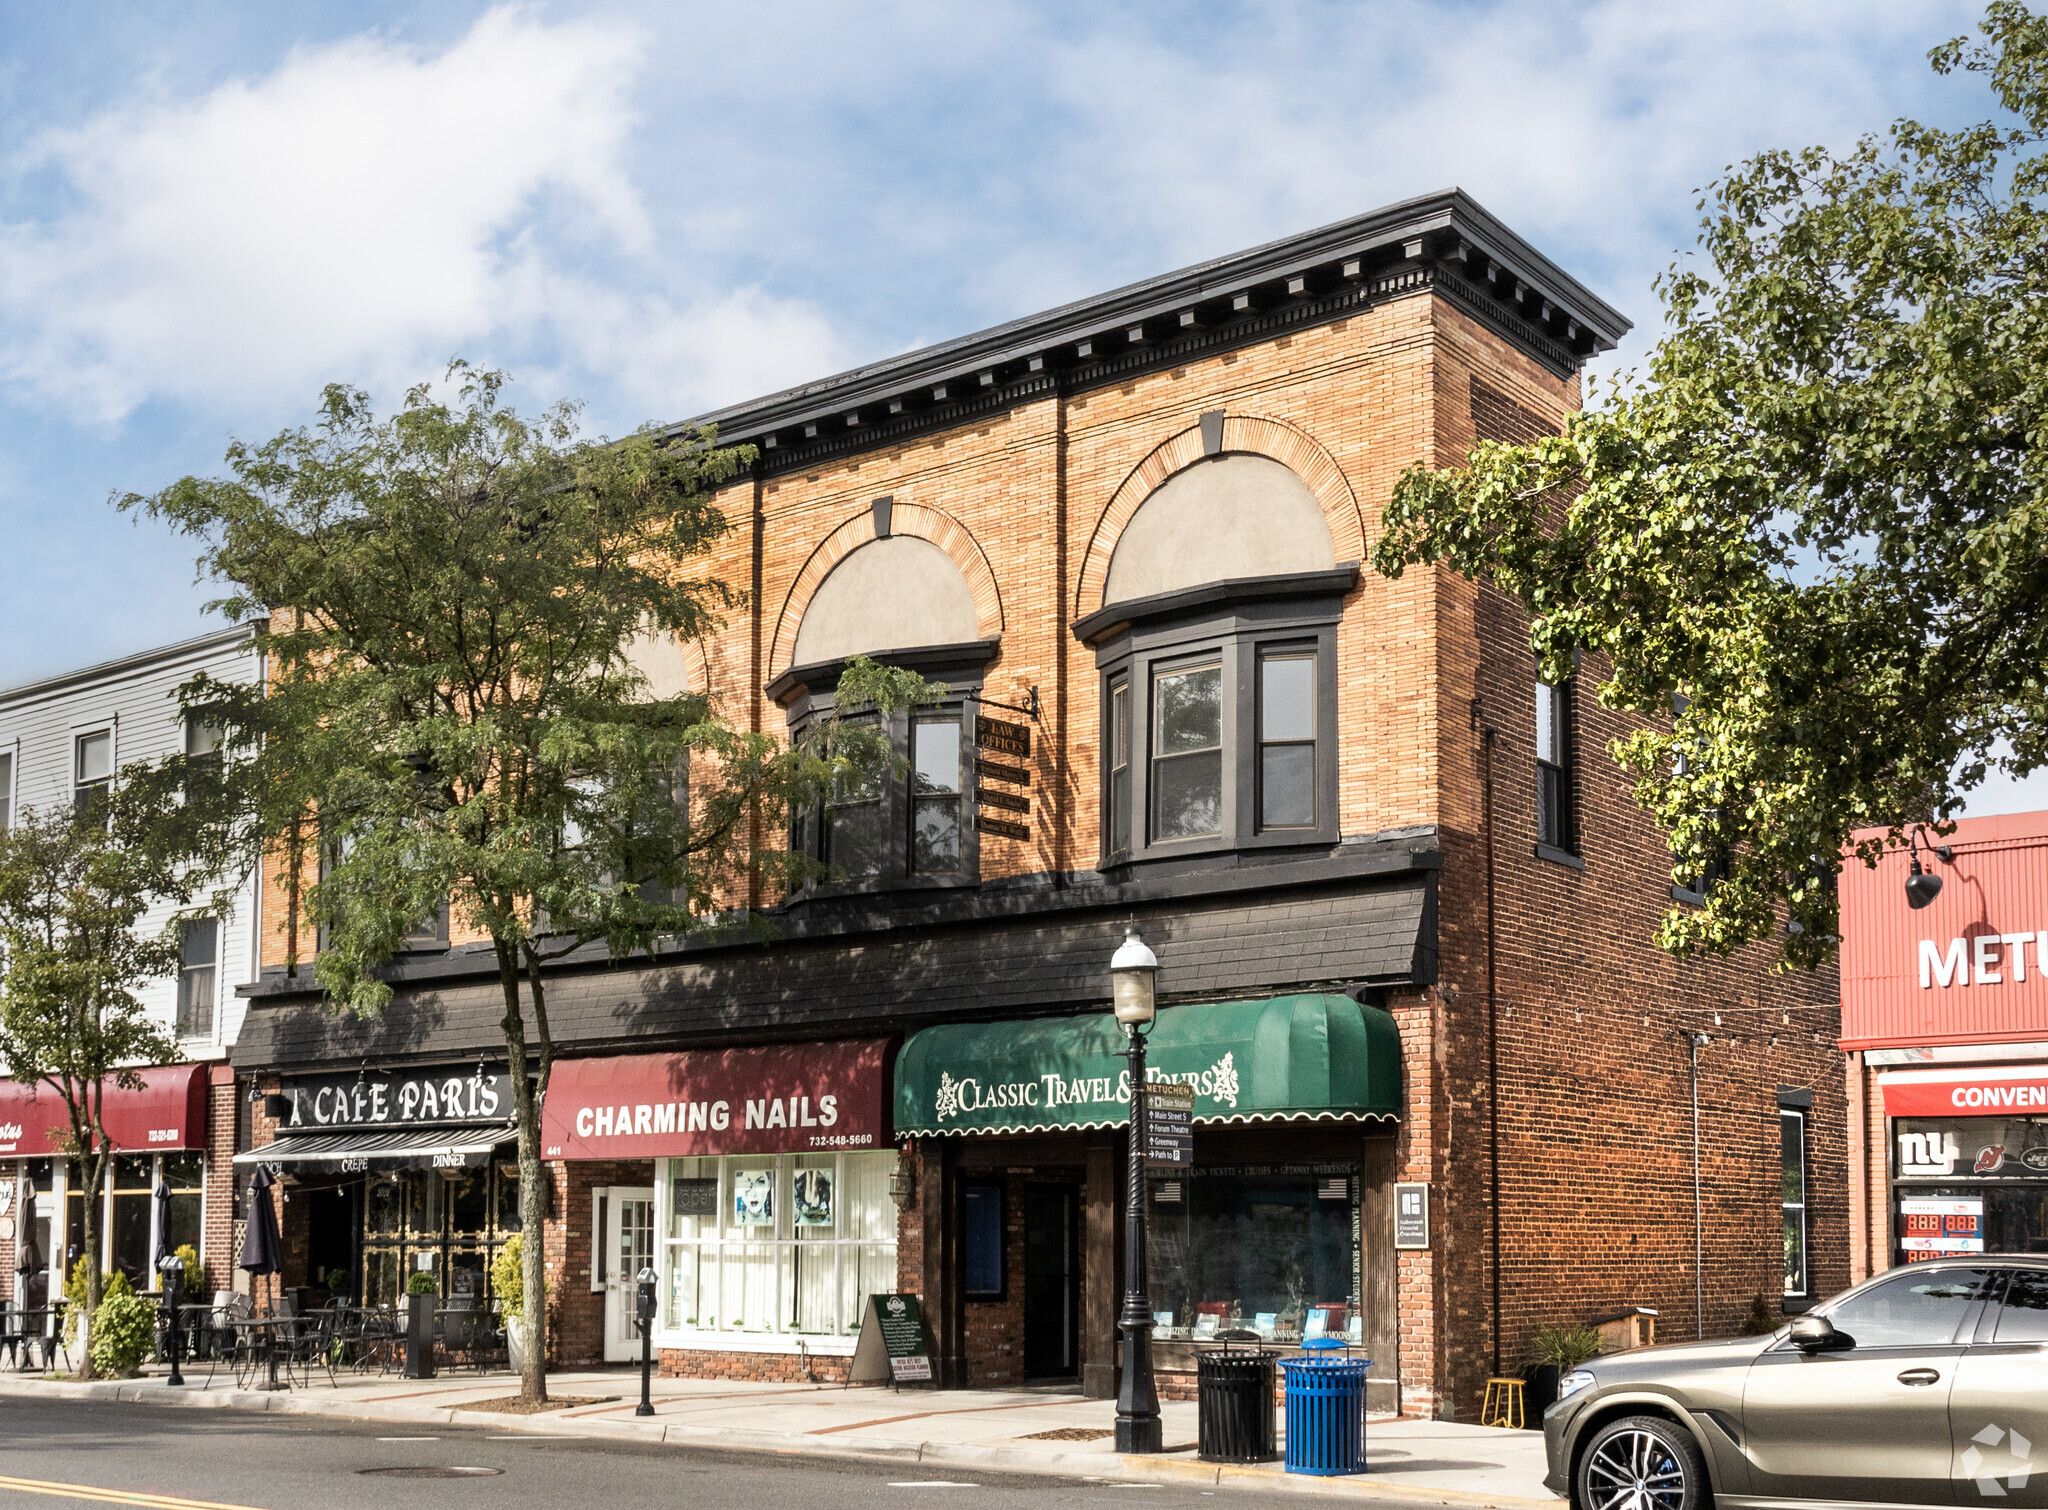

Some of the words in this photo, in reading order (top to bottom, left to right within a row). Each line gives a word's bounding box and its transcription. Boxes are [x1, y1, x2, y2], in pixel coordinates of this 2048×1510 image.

[991, 722, 1015, 737] LAW
[981, 734, 1025, 752] OFFICES
[958, 1078, 1038, 1111] CLASSIC
[1041, 1073, 1115, 1108] TRAVEL
[1115, 1069, 1132, 1104] &
[1146, 1084, 1190, 1095] METUCHEN
[398, 1075, 499, 1120] PARIS
[1951, 1086, 2048, 1107] CONVEN
[1174, 1100, 1192, 1108] Station
[576, 1101, 730, 1138] CHARMING
[745, 1094, 838, 1130] NAILS
[1155, 1111, 1167, 1120] Main
[1167, 1111, 1182, 1120] Street
[1155, 1124, 1170, 1133] Forum
[1170, 1125, 1189, 1134] Theatre
[809, 1134, 872, 1147] 732-548-5660
[1155, 1137, 1179, 1147] Greenway
[546, 1146, 561, 1156] 441
[1155, 1151, 1166, 1159] Path
[432, 1154, 466, 1168] DINNER
[1209, 1167, 1236, 1176] TICKETS
[1244, 1166, 1271, 1175] CRUISES
[1280, 1166, 1310, 1175] GETAWAY
[1312, 1164, 1351, 1175] WEEKENDS
[1352, 1175, 1360, 1205] MEETING
[1352, 1207, 1361, 1242] PLANNING
